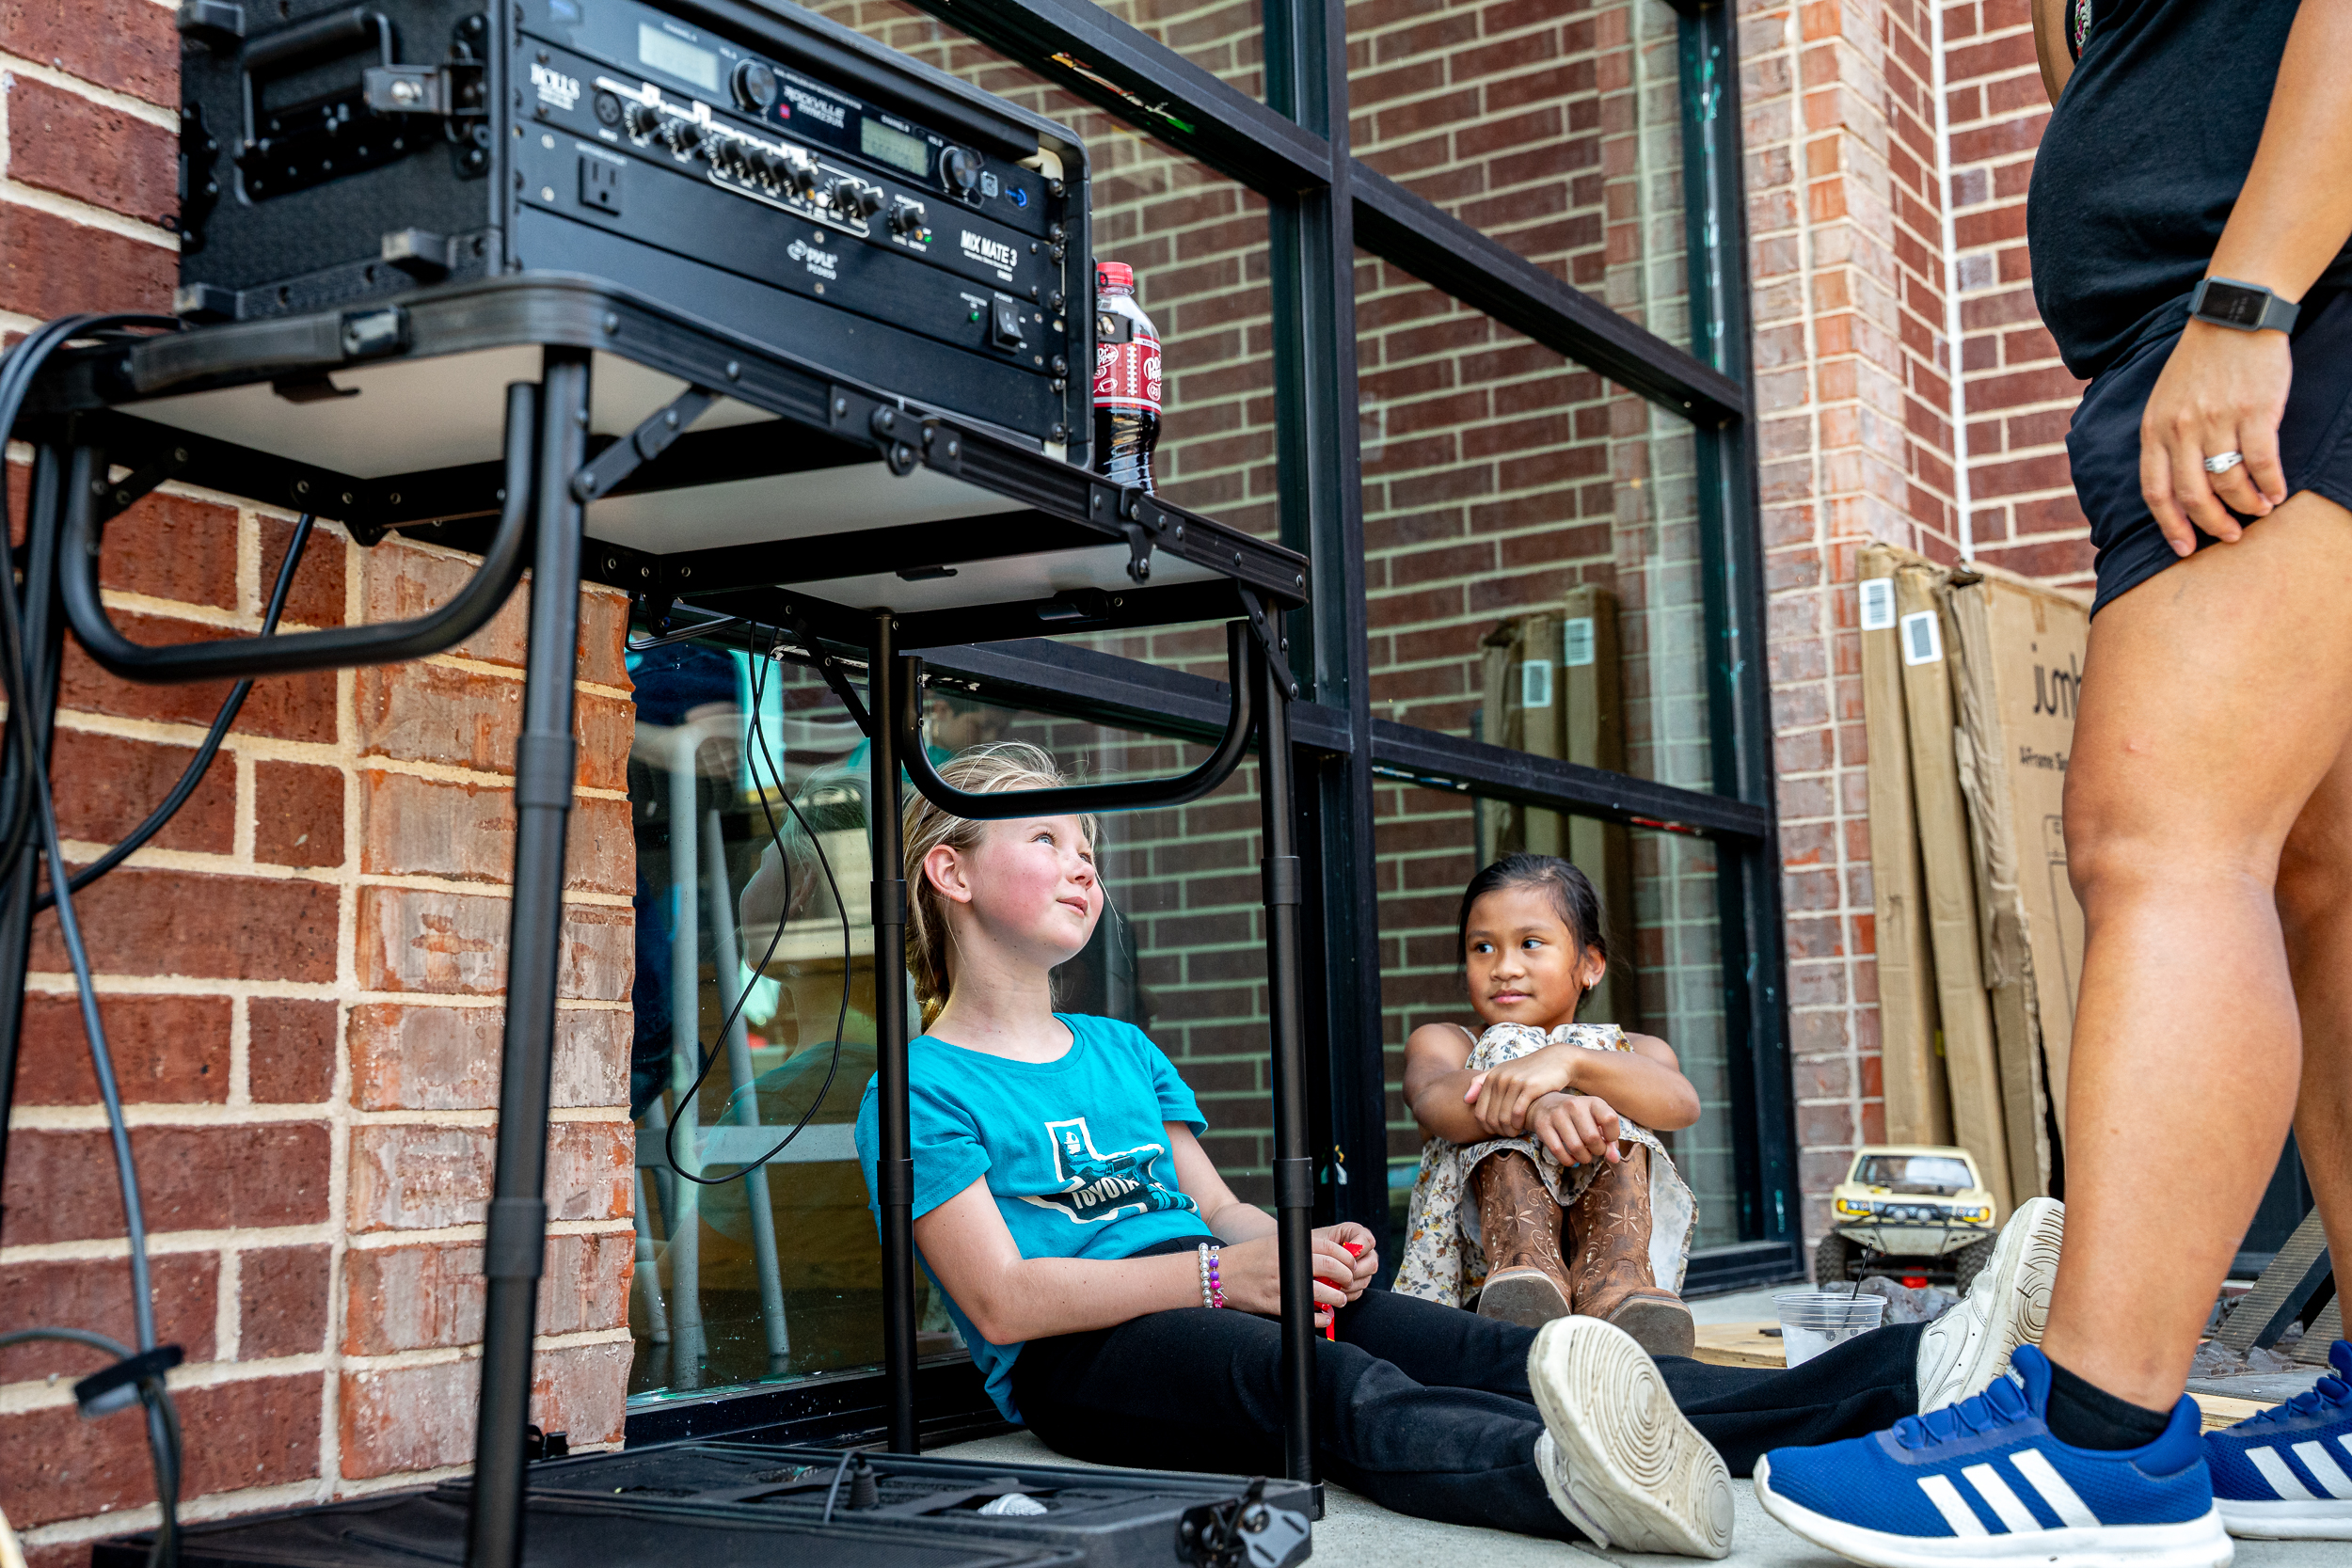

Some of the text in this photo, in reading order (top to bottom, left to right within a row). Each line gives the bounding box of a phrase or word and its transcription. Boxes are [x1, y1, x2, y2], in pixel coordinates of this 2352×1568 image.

[960, 230, 982, 254] MIX
[980, 236, 1010, 264] MATE
[1009, 248, 1018, 267] 3
